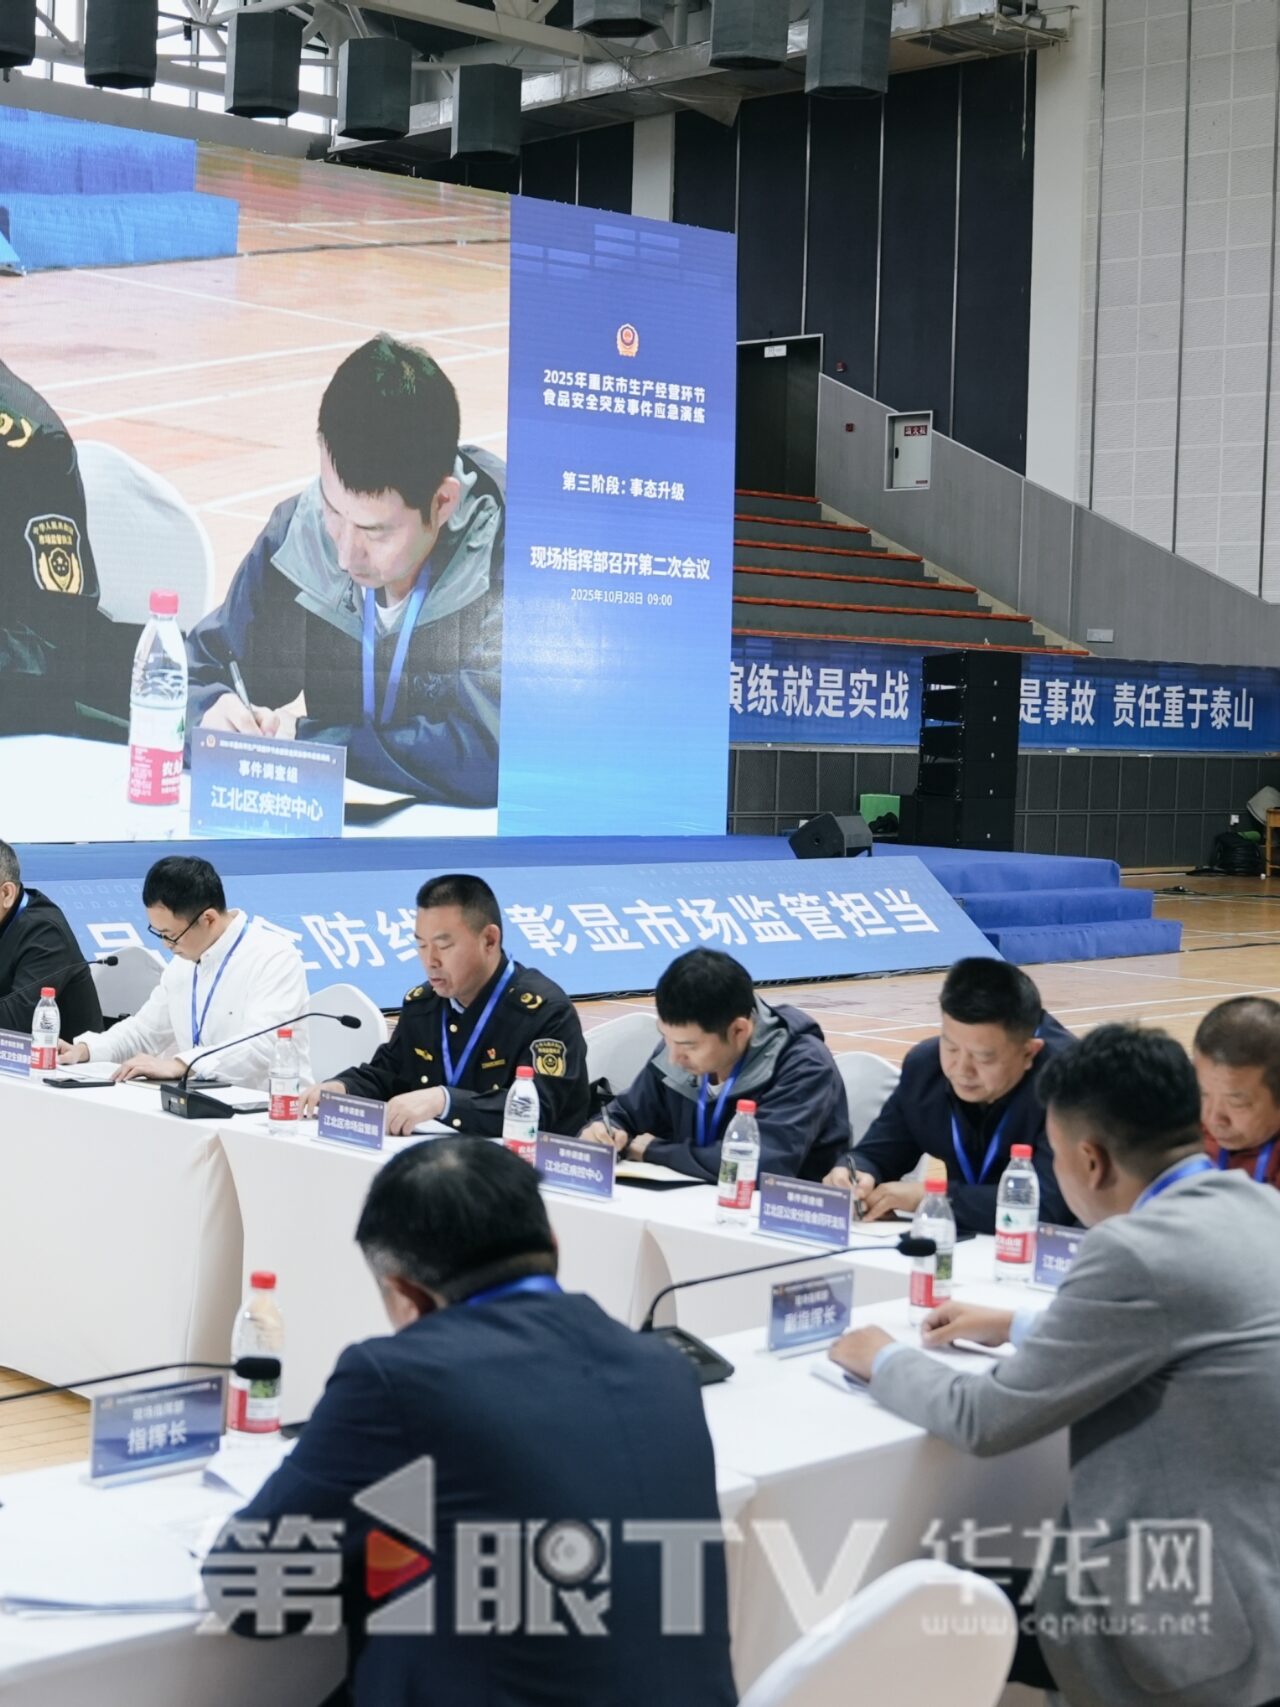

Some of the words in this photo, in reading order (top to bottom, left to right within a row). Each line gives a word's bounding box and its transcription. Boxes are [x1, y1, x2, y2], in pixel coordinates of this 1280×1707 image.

[543, 369, 706, 404] 2025年重庆市生产经营环节
[543, 389, 706, 424] 食品安全突发事件应急演练
[530, 546, 711, 581] 现场指挥部召开第二次会议
[571, 588, 644, 605] 2025年10月28日
[647, 594, 673, 606] 09:00
[1113, 680, 1254, 731] 责任重于泰山
[210, 784, 323, 822] 江北区疾控中心
[505, 887, 939, 958] 彰显市场监管担当
[127, 1420, 187, 1456] 指挥长
